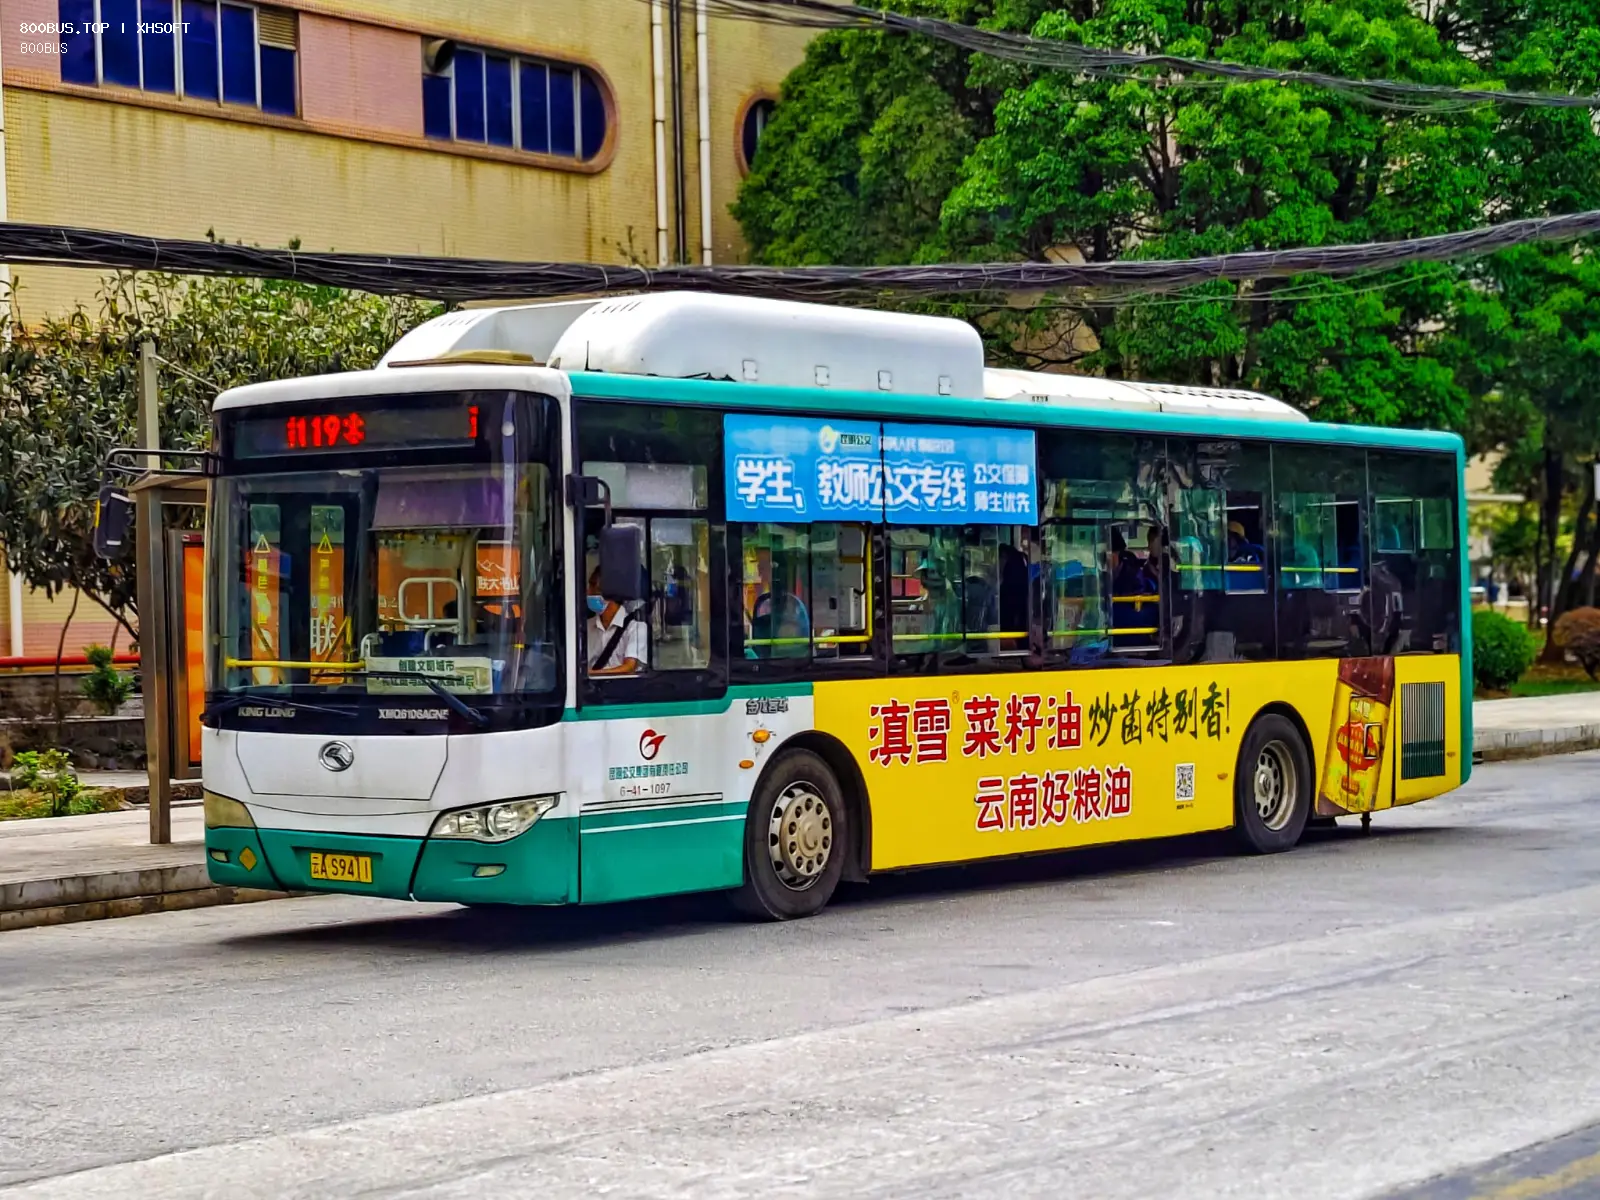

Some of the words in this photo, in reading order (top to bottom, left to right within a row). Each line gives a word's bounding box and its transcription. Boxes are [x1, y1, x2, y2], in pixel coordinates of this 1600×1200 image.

[238, 706, 264, 717] KING
[265, 707, 296, 718] LONG
[974, 766, 1133, 832] 云南好粮油
